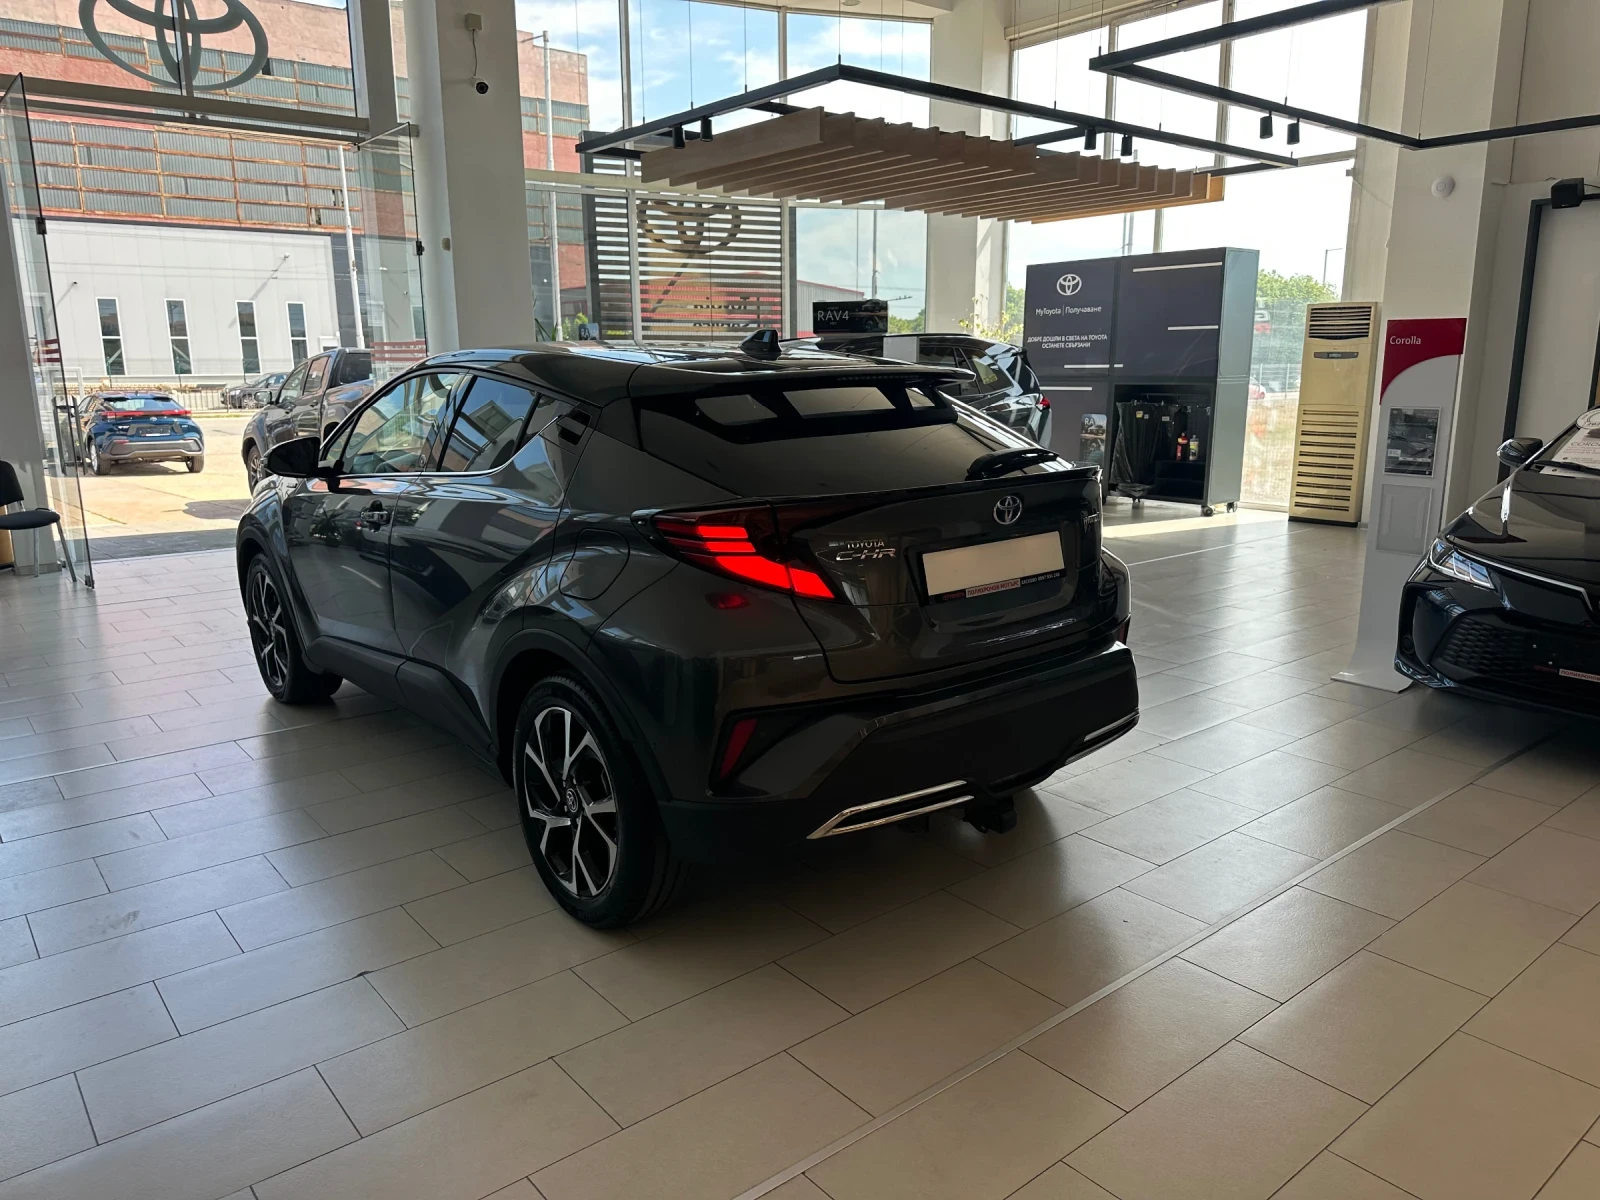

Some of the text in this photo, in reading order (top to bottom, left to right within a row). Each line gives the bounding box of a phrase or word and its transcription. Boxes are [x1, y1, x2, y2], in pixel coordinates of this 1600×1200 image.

[817, 310, 849, 321] RAV4
[1035, 306, 1102, 317] MyToyota Получаване
[1389, 335, 1422, 345] Corolla
[845, 539, 885, 549] TOYOTA
[835, 548, 896, 561] C-HR
[967, 585, 1000, 596] ПОЛИХРОНОВ
[1000, 580, 1020, 590] МОТЪРС
